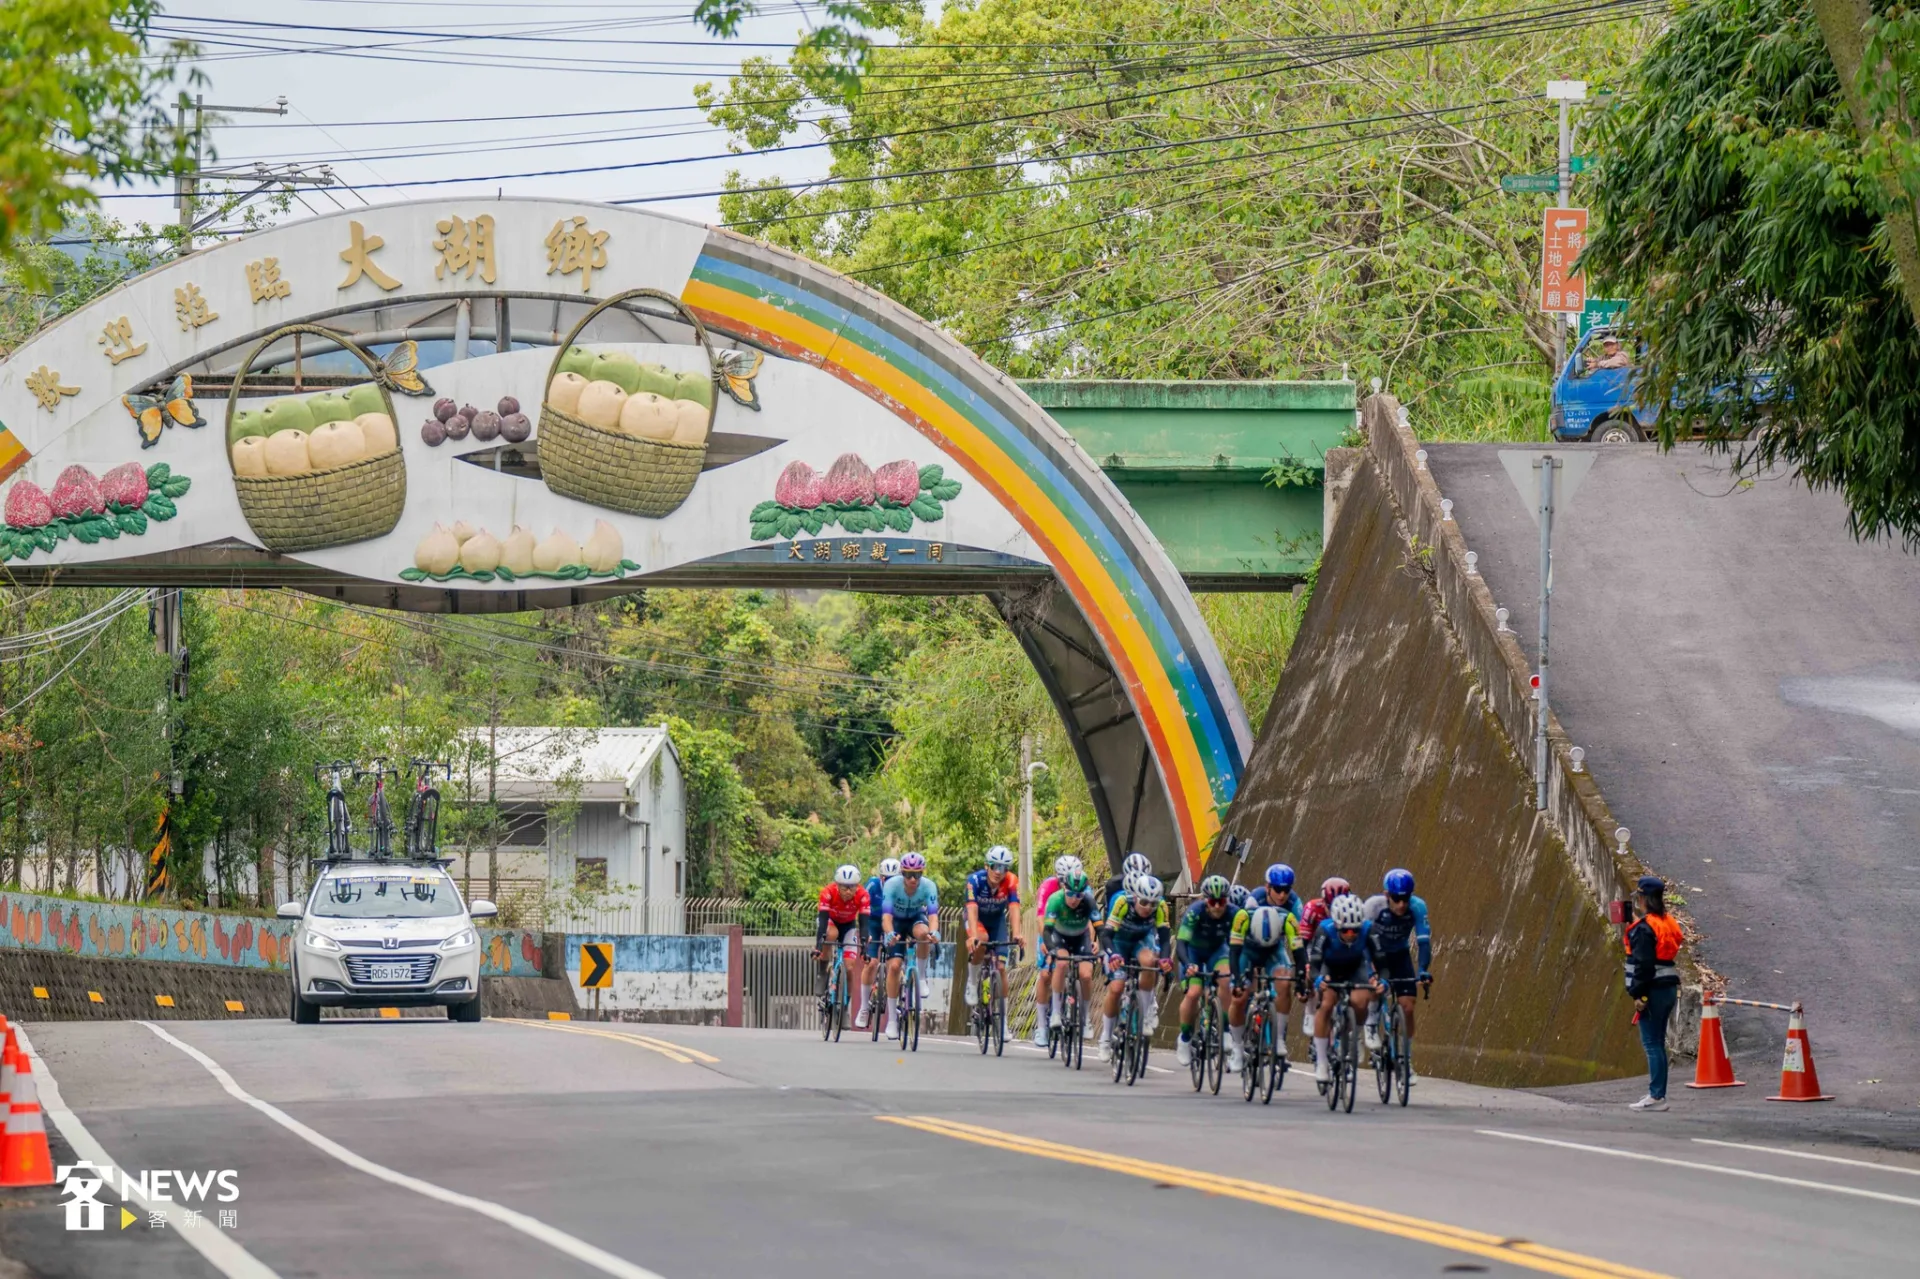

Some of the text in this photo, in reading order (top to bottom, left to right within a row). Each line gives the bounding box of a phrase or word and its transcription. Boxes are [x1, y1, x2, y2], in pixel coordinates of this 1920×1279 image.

[1546, 231, 1562, 307] 土地公廟
[788, 540, 944, 562] 大湖鄉親一同
